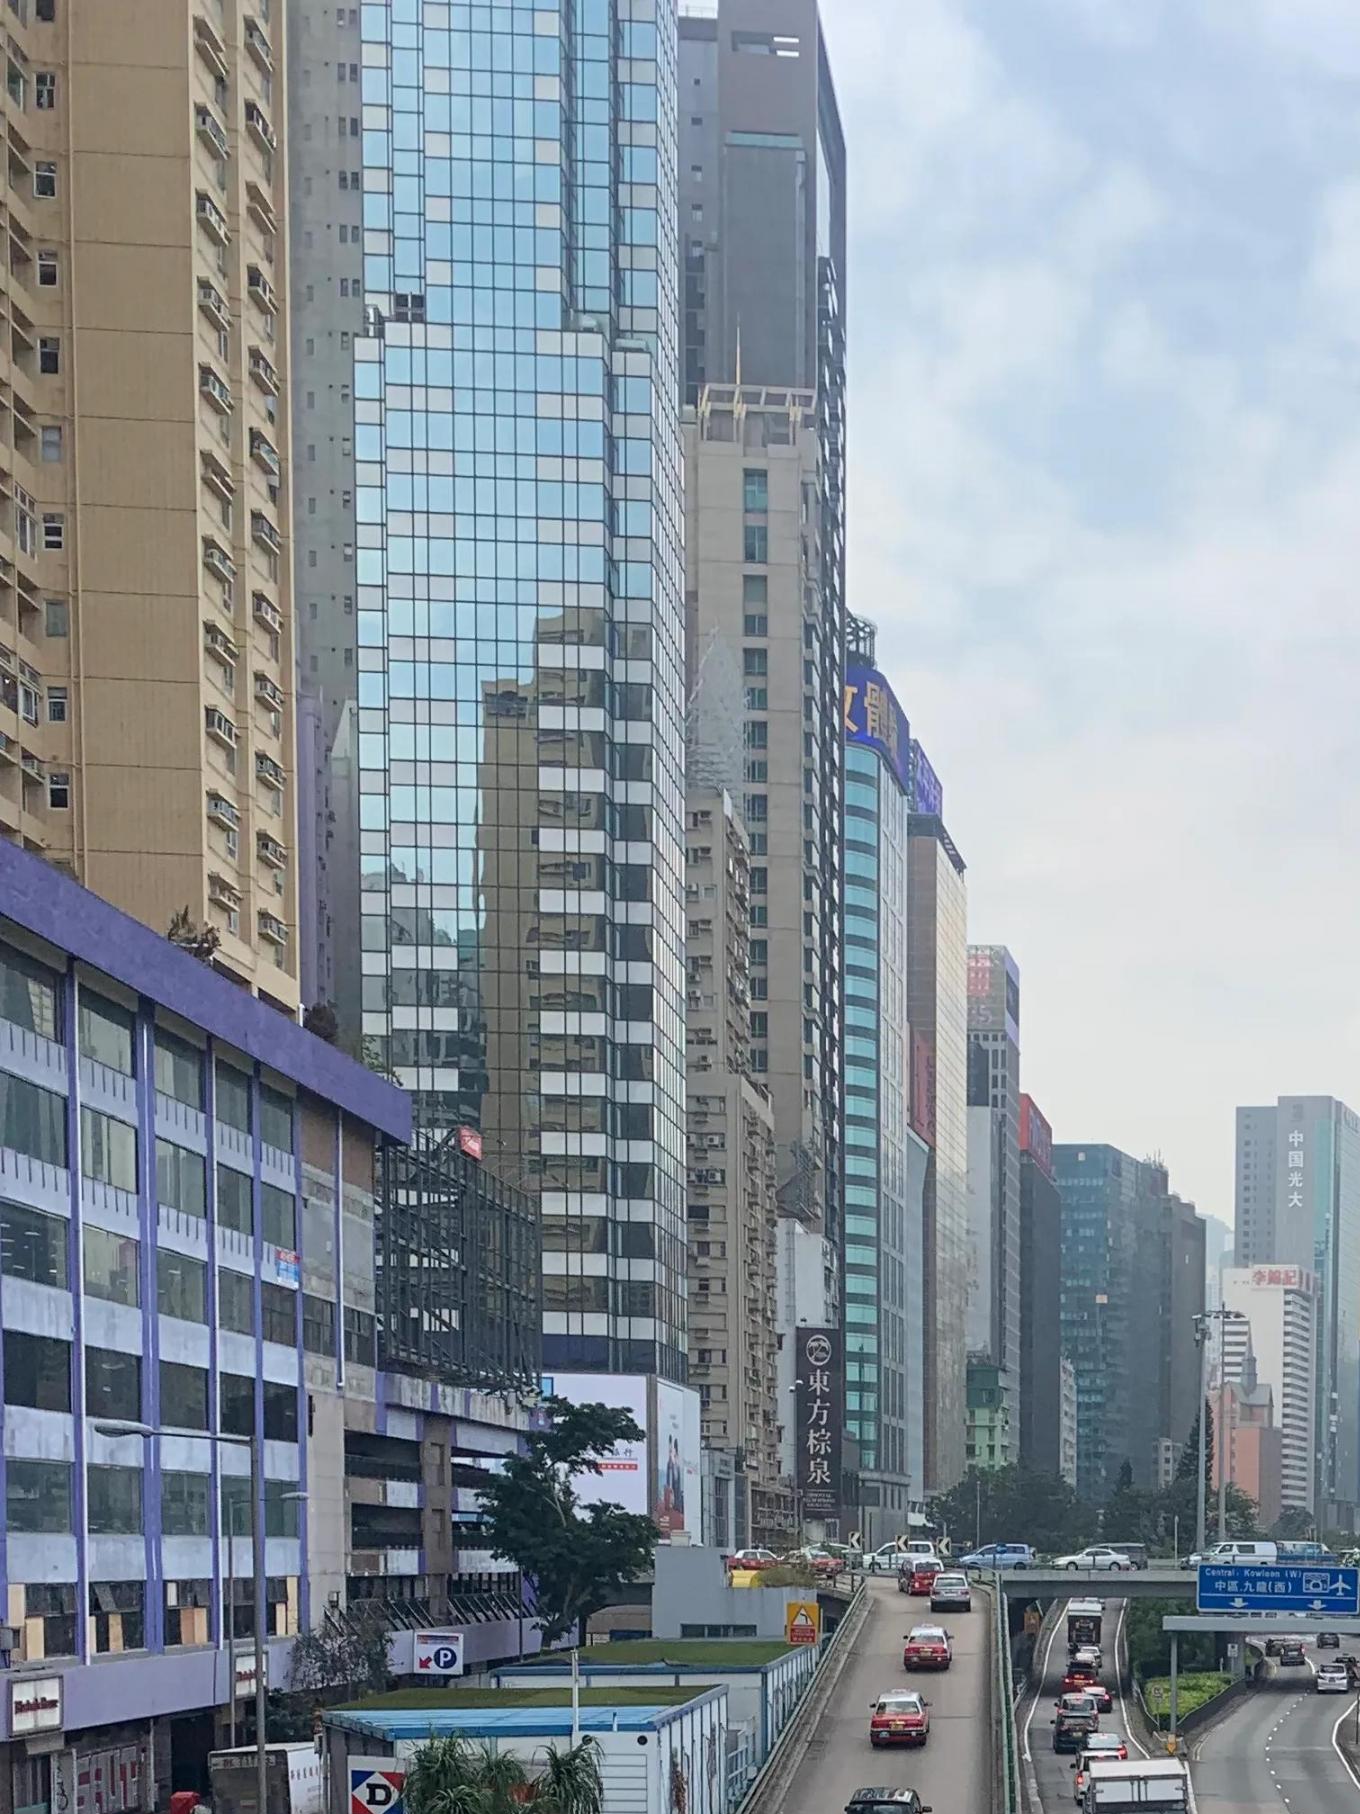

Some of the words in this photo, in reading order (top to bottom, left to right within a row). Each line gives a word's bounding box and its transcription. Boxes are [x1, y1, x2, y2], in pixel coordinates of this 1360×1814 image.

[1288, 1130, 1304, 1208] 中国光大
[806, 1369, 832, 1485] 東方棕泉
[1244, 1569, 1280, 1578] Kowloon
[439, 1650, 451, 1667] P
[366, 1783, 392, 1806] D
